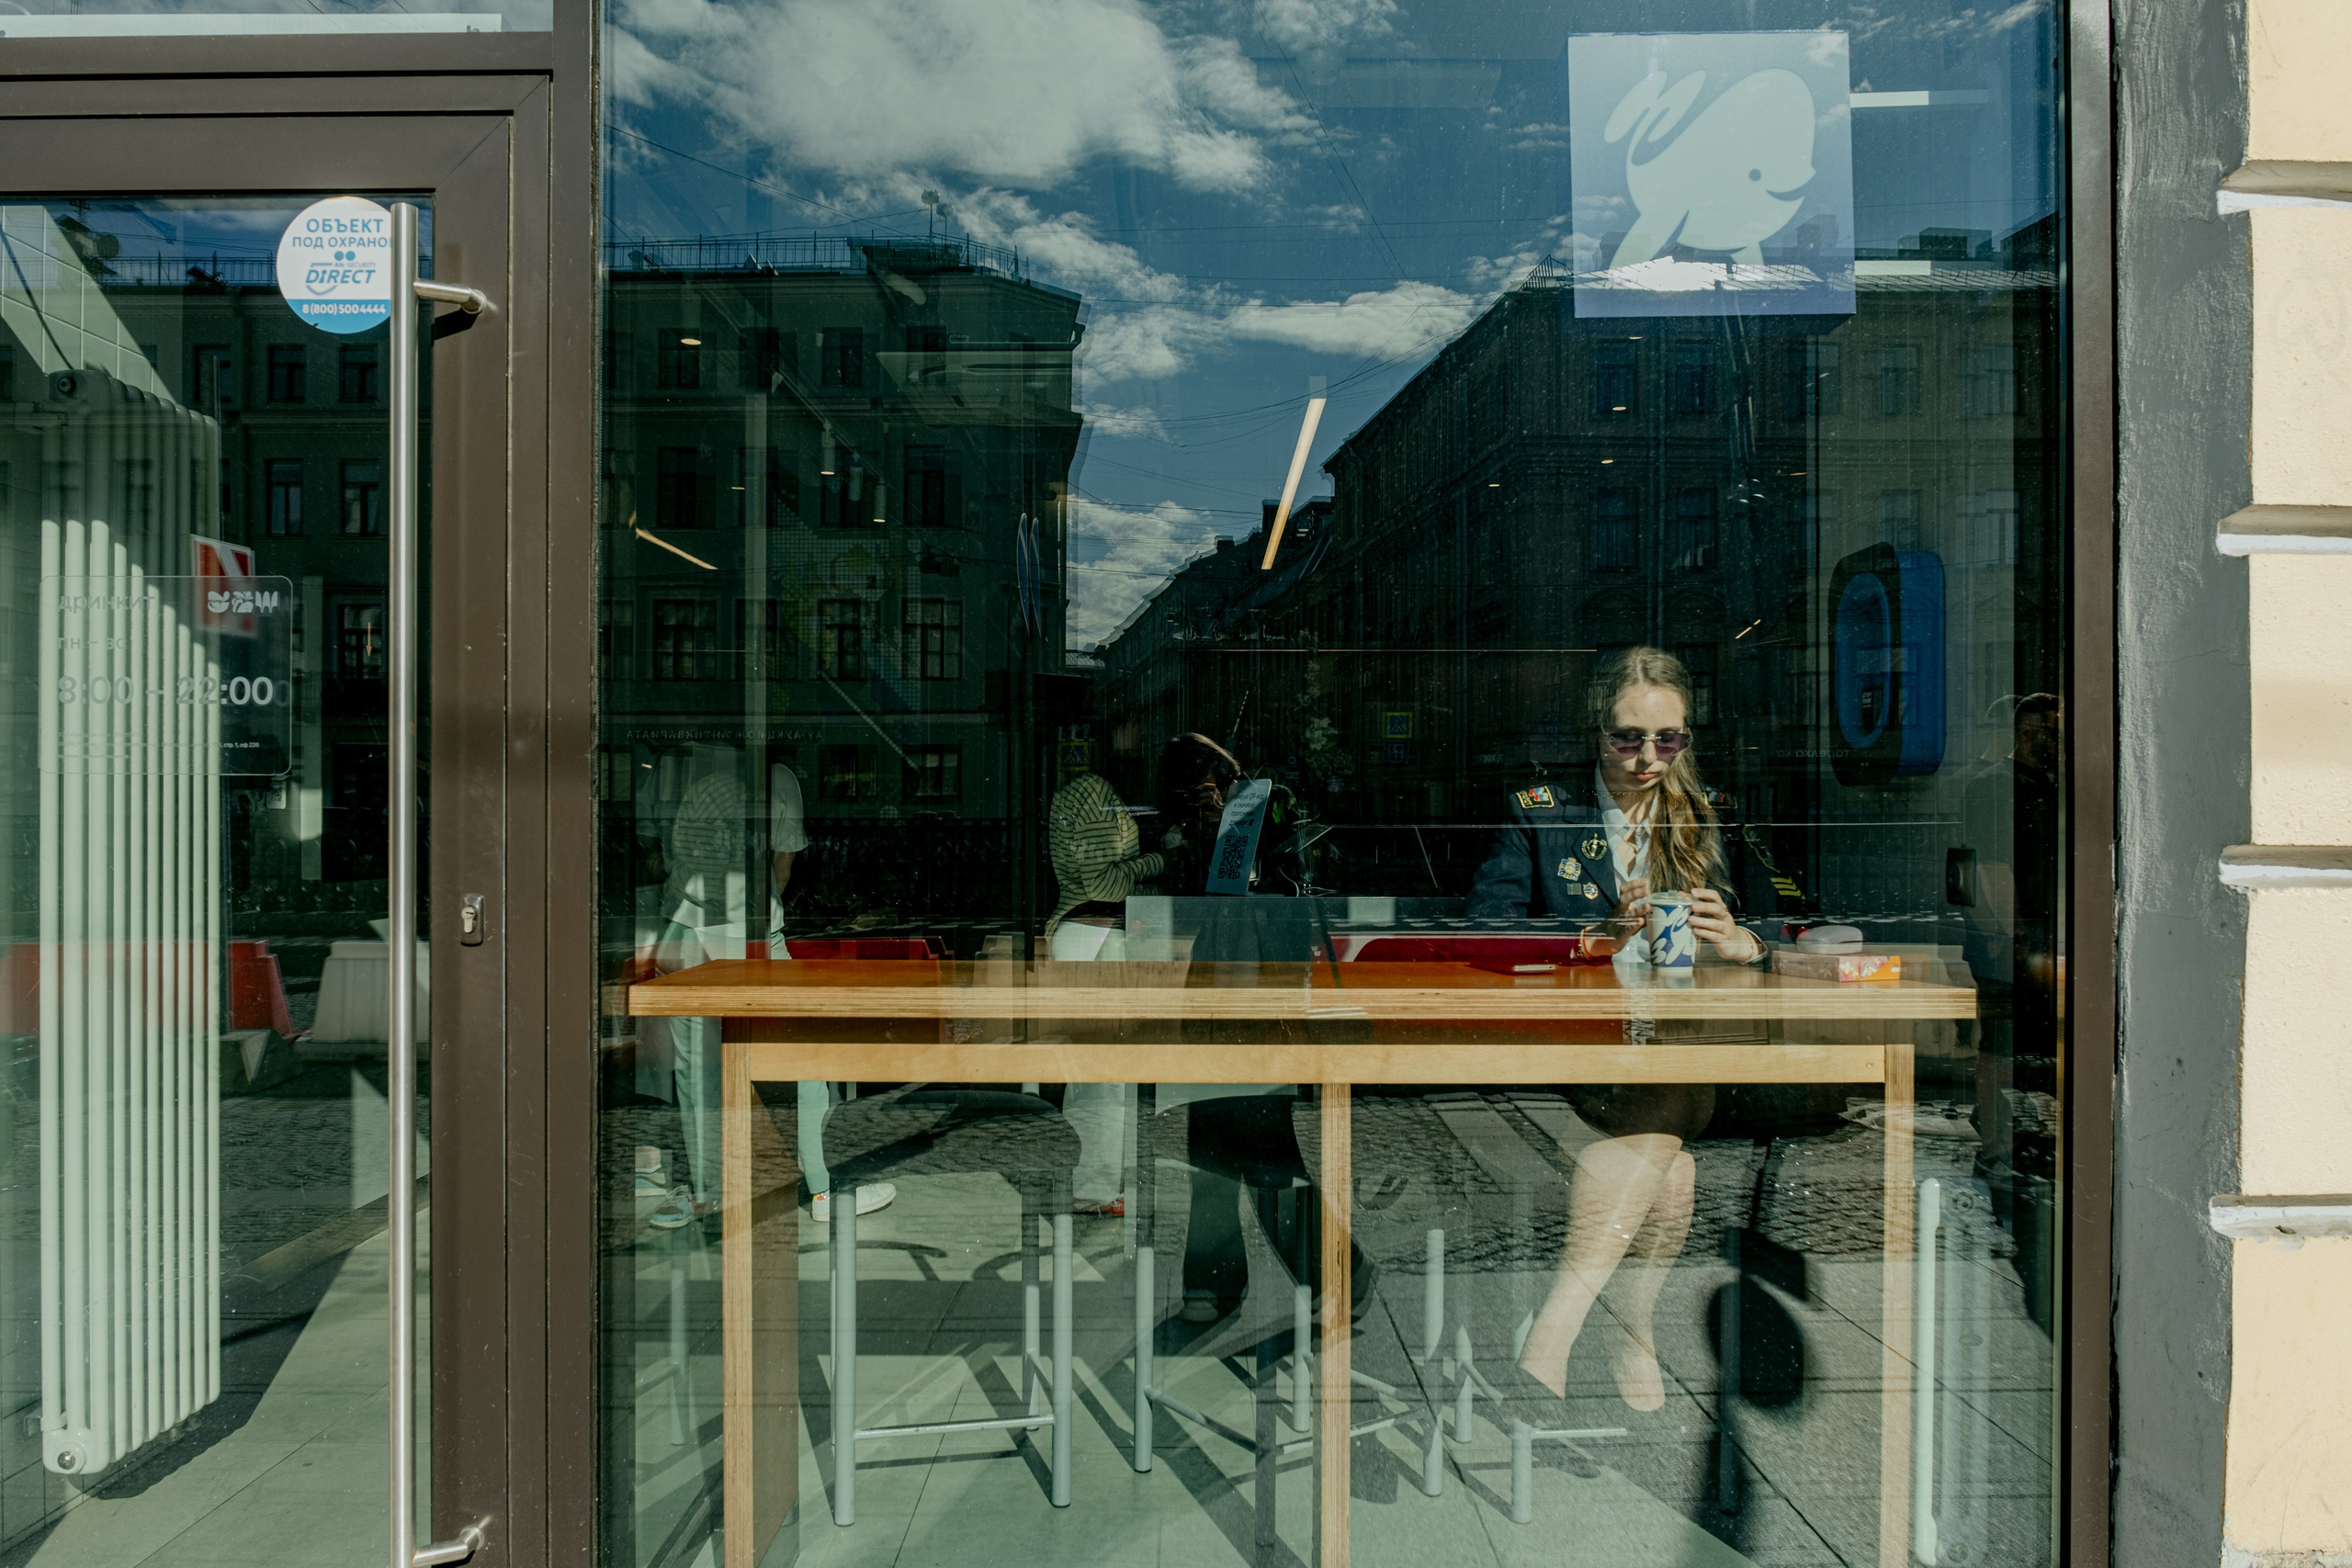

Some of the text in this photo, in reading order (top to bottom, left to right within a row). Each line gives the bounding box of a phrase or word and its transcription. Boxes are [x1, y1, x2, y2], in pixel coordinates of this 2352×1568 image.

[306, 219, 383, 232] ОБЪЕКТ
[292, 237, 323, 249] ПОД
[302, 304, 308, 314] 8
[311, 303, 337, 315] (800)
[58, 595, 155, 614] дринкит
[58, 676, 134, 705] 8:00
[175, 676, 274, 705] 22:00
